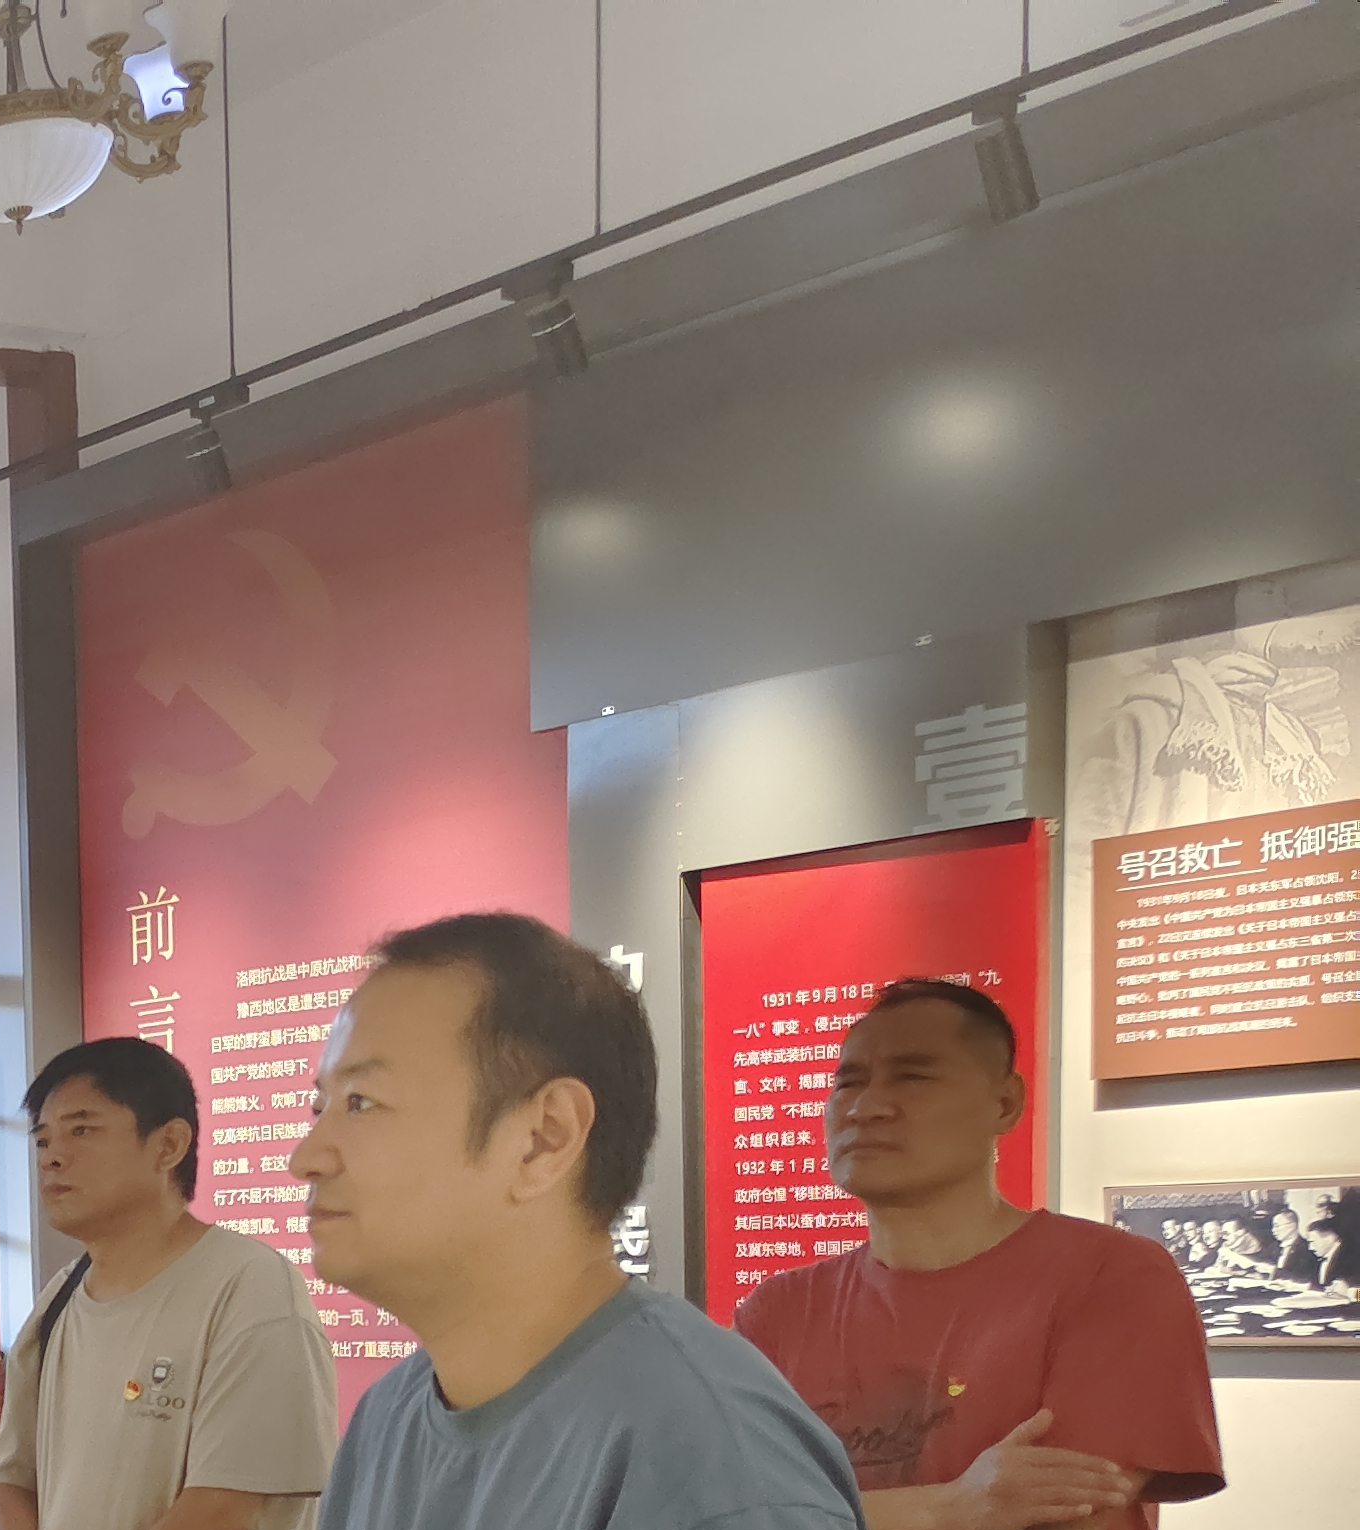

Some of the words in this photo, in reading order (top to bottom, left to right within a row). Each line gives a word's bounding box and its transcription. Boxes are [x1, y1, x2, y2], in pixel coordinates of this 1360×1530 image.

[912, 702, 1028, 833] 壹
[1117, 837, 1243, 881] 号召救亡
[1260, 820, 1360, 864] 抵御强
[126, 885, 181, 1053] 前言
